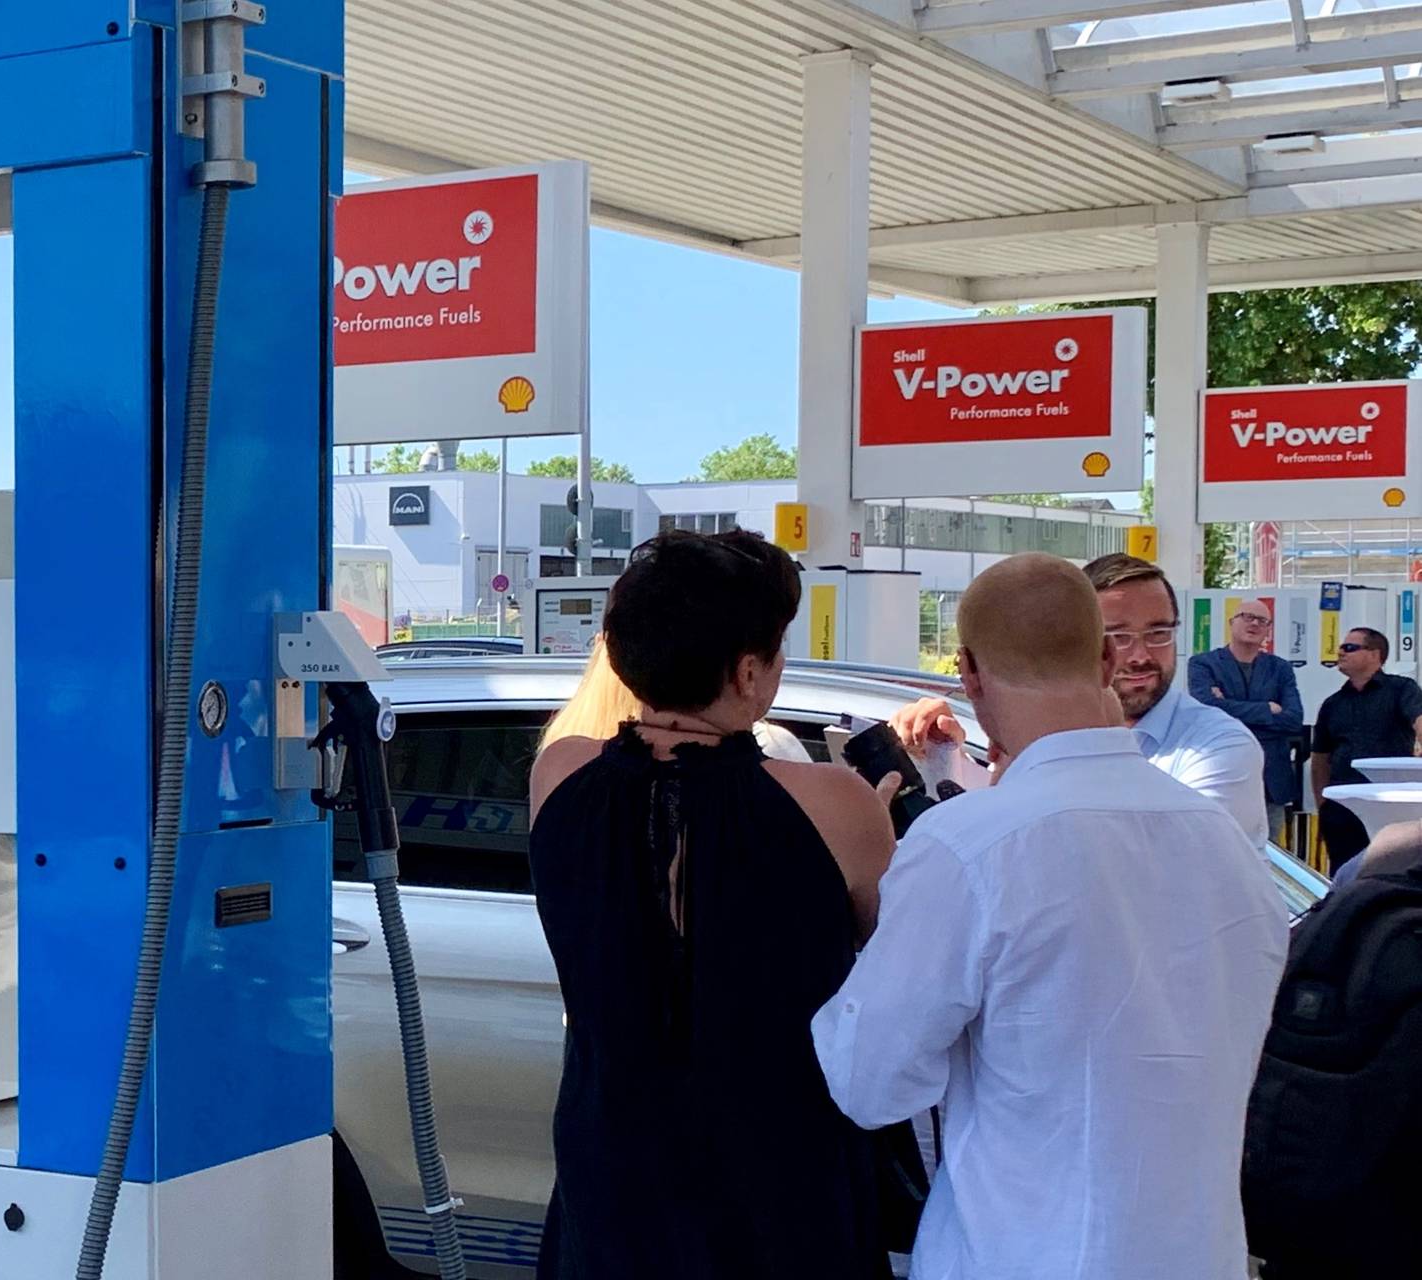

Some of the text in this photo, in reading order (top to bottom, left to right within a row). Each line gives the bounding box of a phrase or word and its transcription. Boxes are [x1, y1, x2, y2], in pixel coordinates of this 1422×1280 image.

[439, 304, 482, 326] Fuels
[893, 349, 925, 363] Shell
[893, 366, 1070, 401] V-Power
[950, 402, 1070, 420] Performance Fuels
[1231, 408, 1257, 420] Shell
[1230, 422, 1373, 448] V-Power
[1276, 450, 1373, 464] Performance Fuels
[395, 506, 422, 514] MAN
[794, 516, 803, 539] 5
[1142, 535, 1153, 553] 7
[301, 664, 340, 673] 350 BAR
